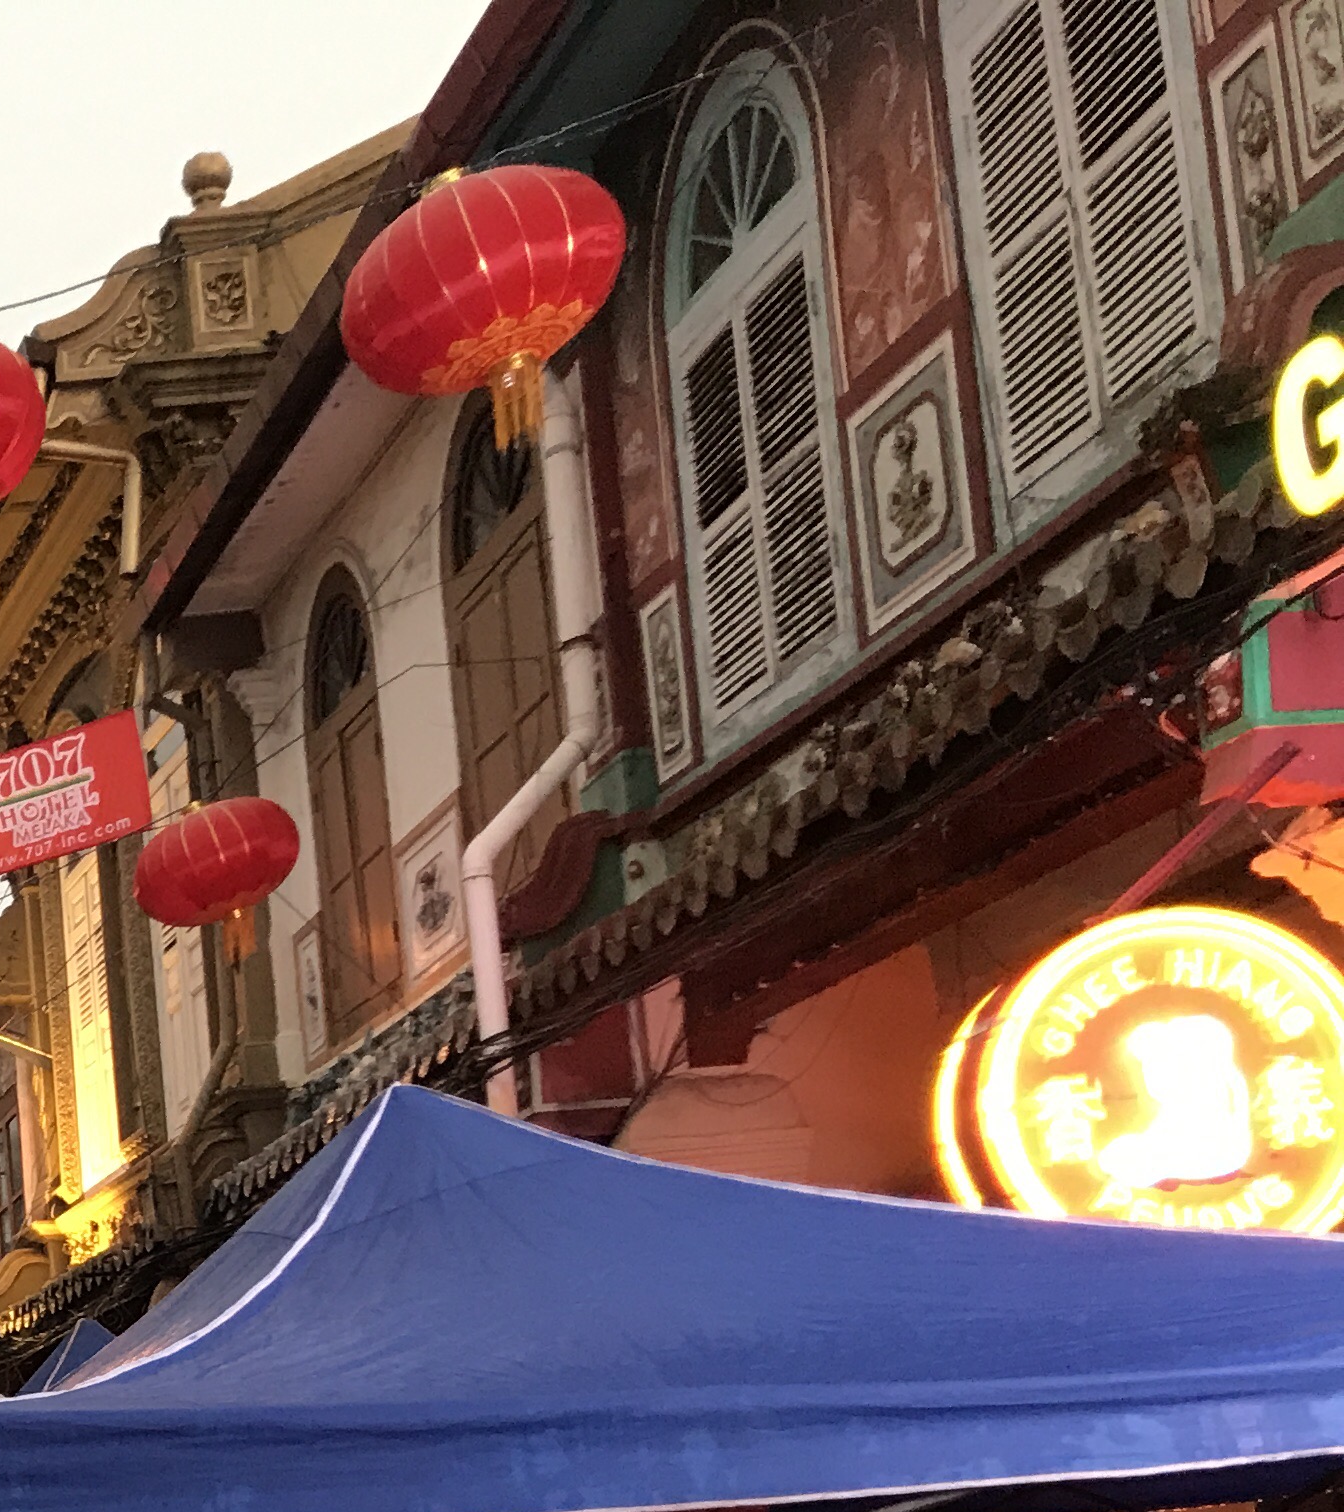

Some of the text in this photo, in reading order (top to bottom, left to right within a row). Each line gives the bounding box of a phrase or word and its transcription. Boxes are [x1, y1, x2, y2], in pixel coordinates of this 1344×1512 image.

[15, 811, 90, 846] MELAKA
[1041, 948, 1315, 1057] GHEE HIANG
[1033, 1075, 1107, 1162] 香
